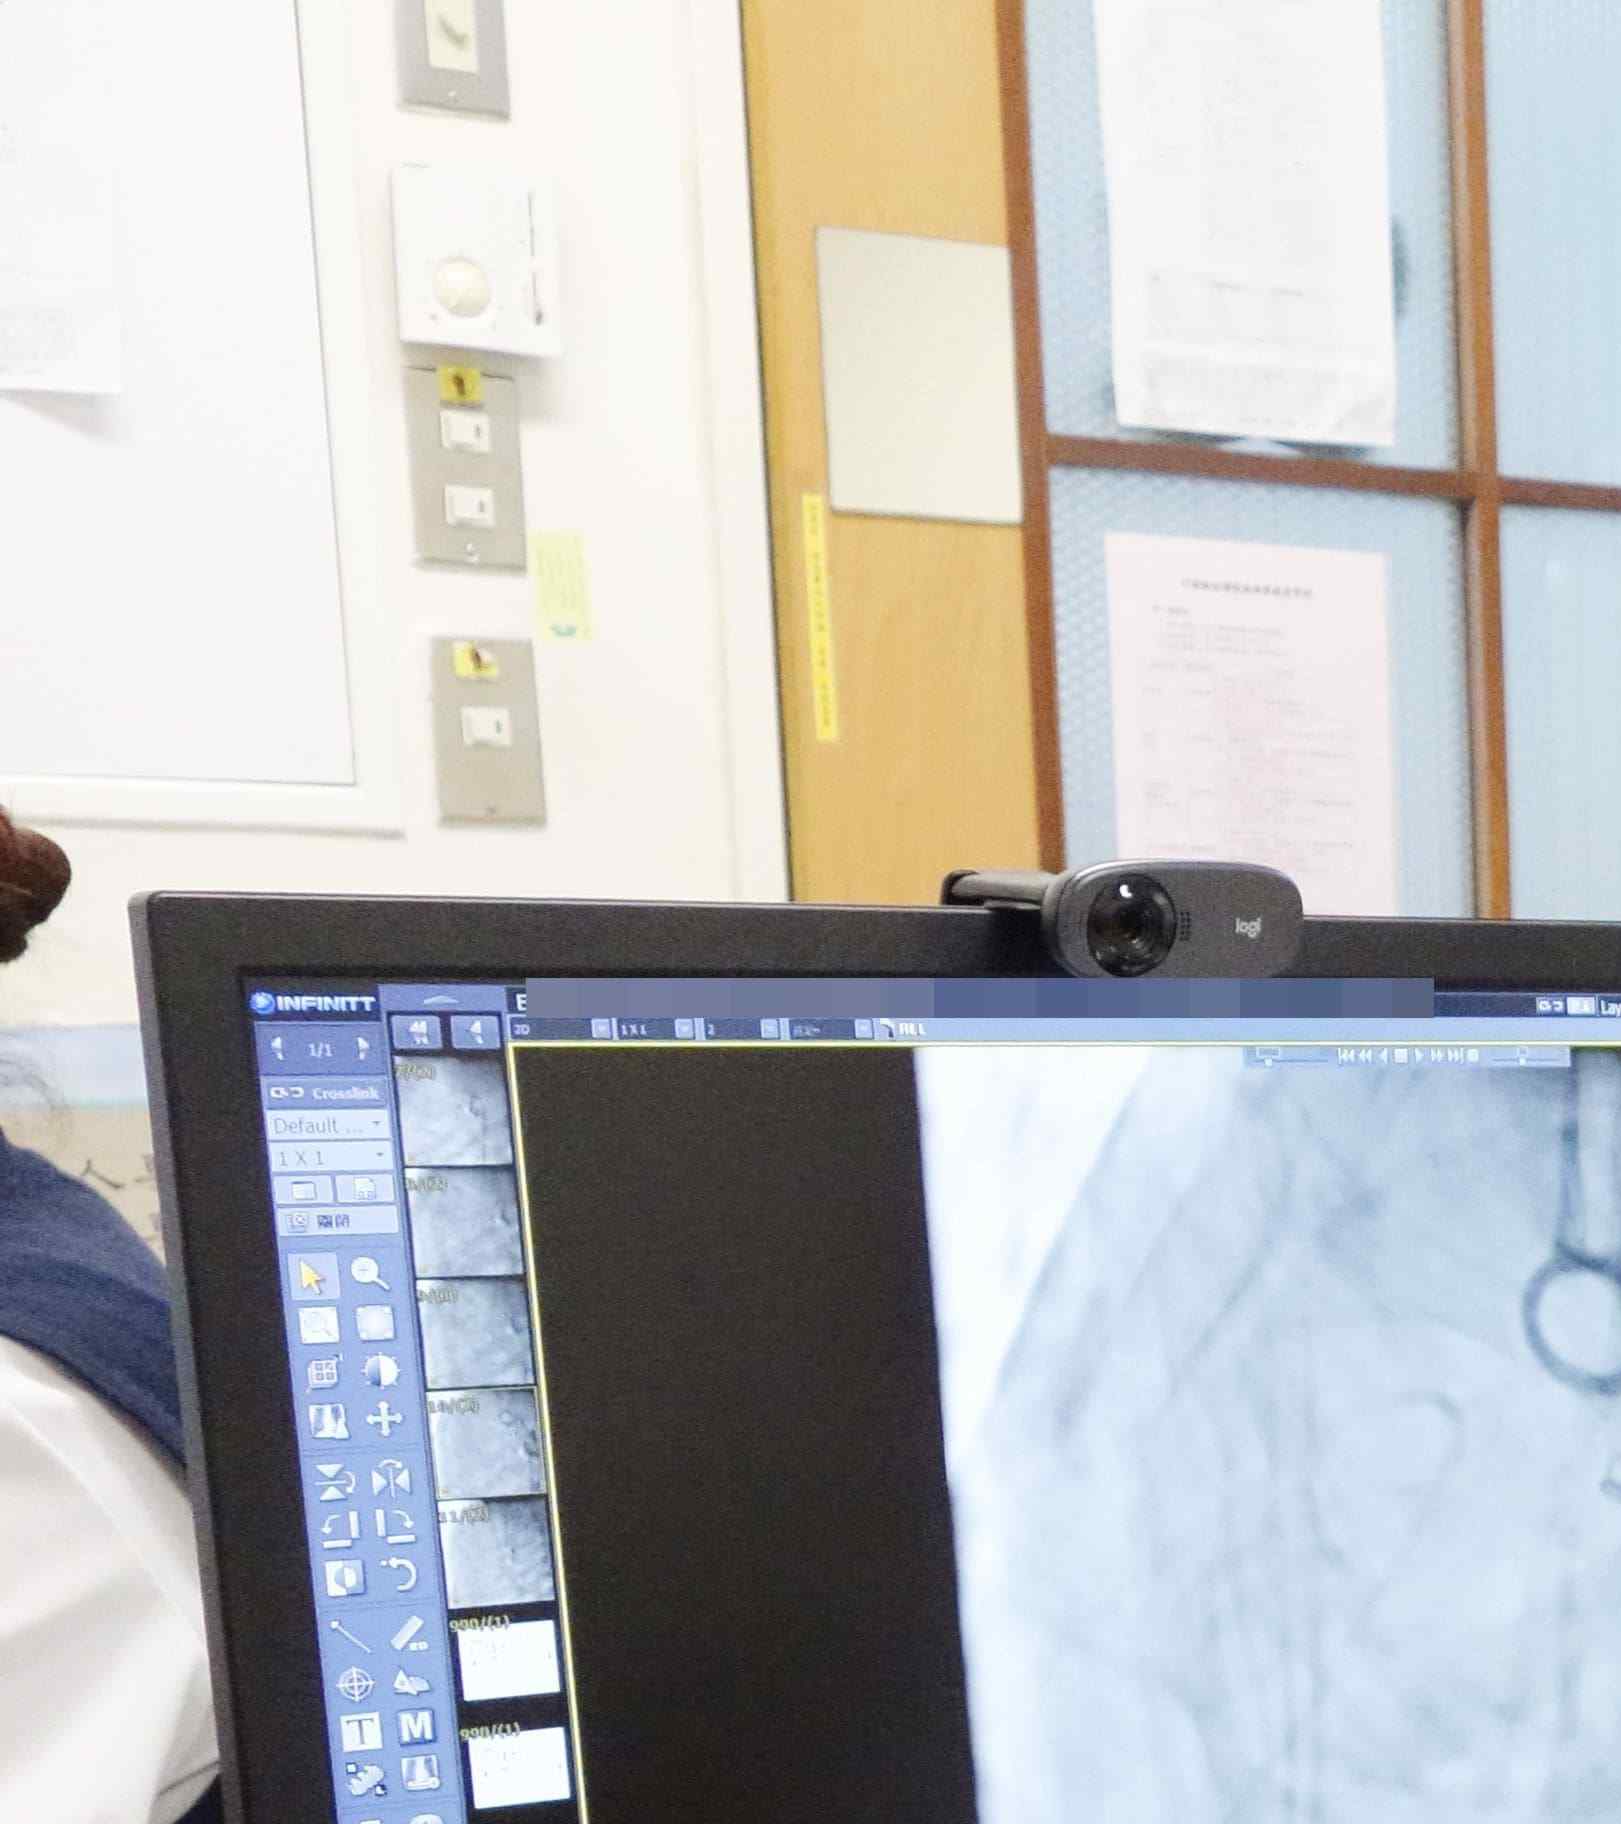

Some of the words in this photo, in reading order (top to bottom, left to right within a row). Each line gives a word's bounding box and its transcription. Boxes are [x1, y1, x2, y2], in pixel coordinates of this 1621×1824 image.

[1235, 917, 1262, 939] logi
[277, 995, 377, 1012] INFINITT
[312, 1086, 380, 1101] Crosslink
[273, 1117, 340, 1134] Default
